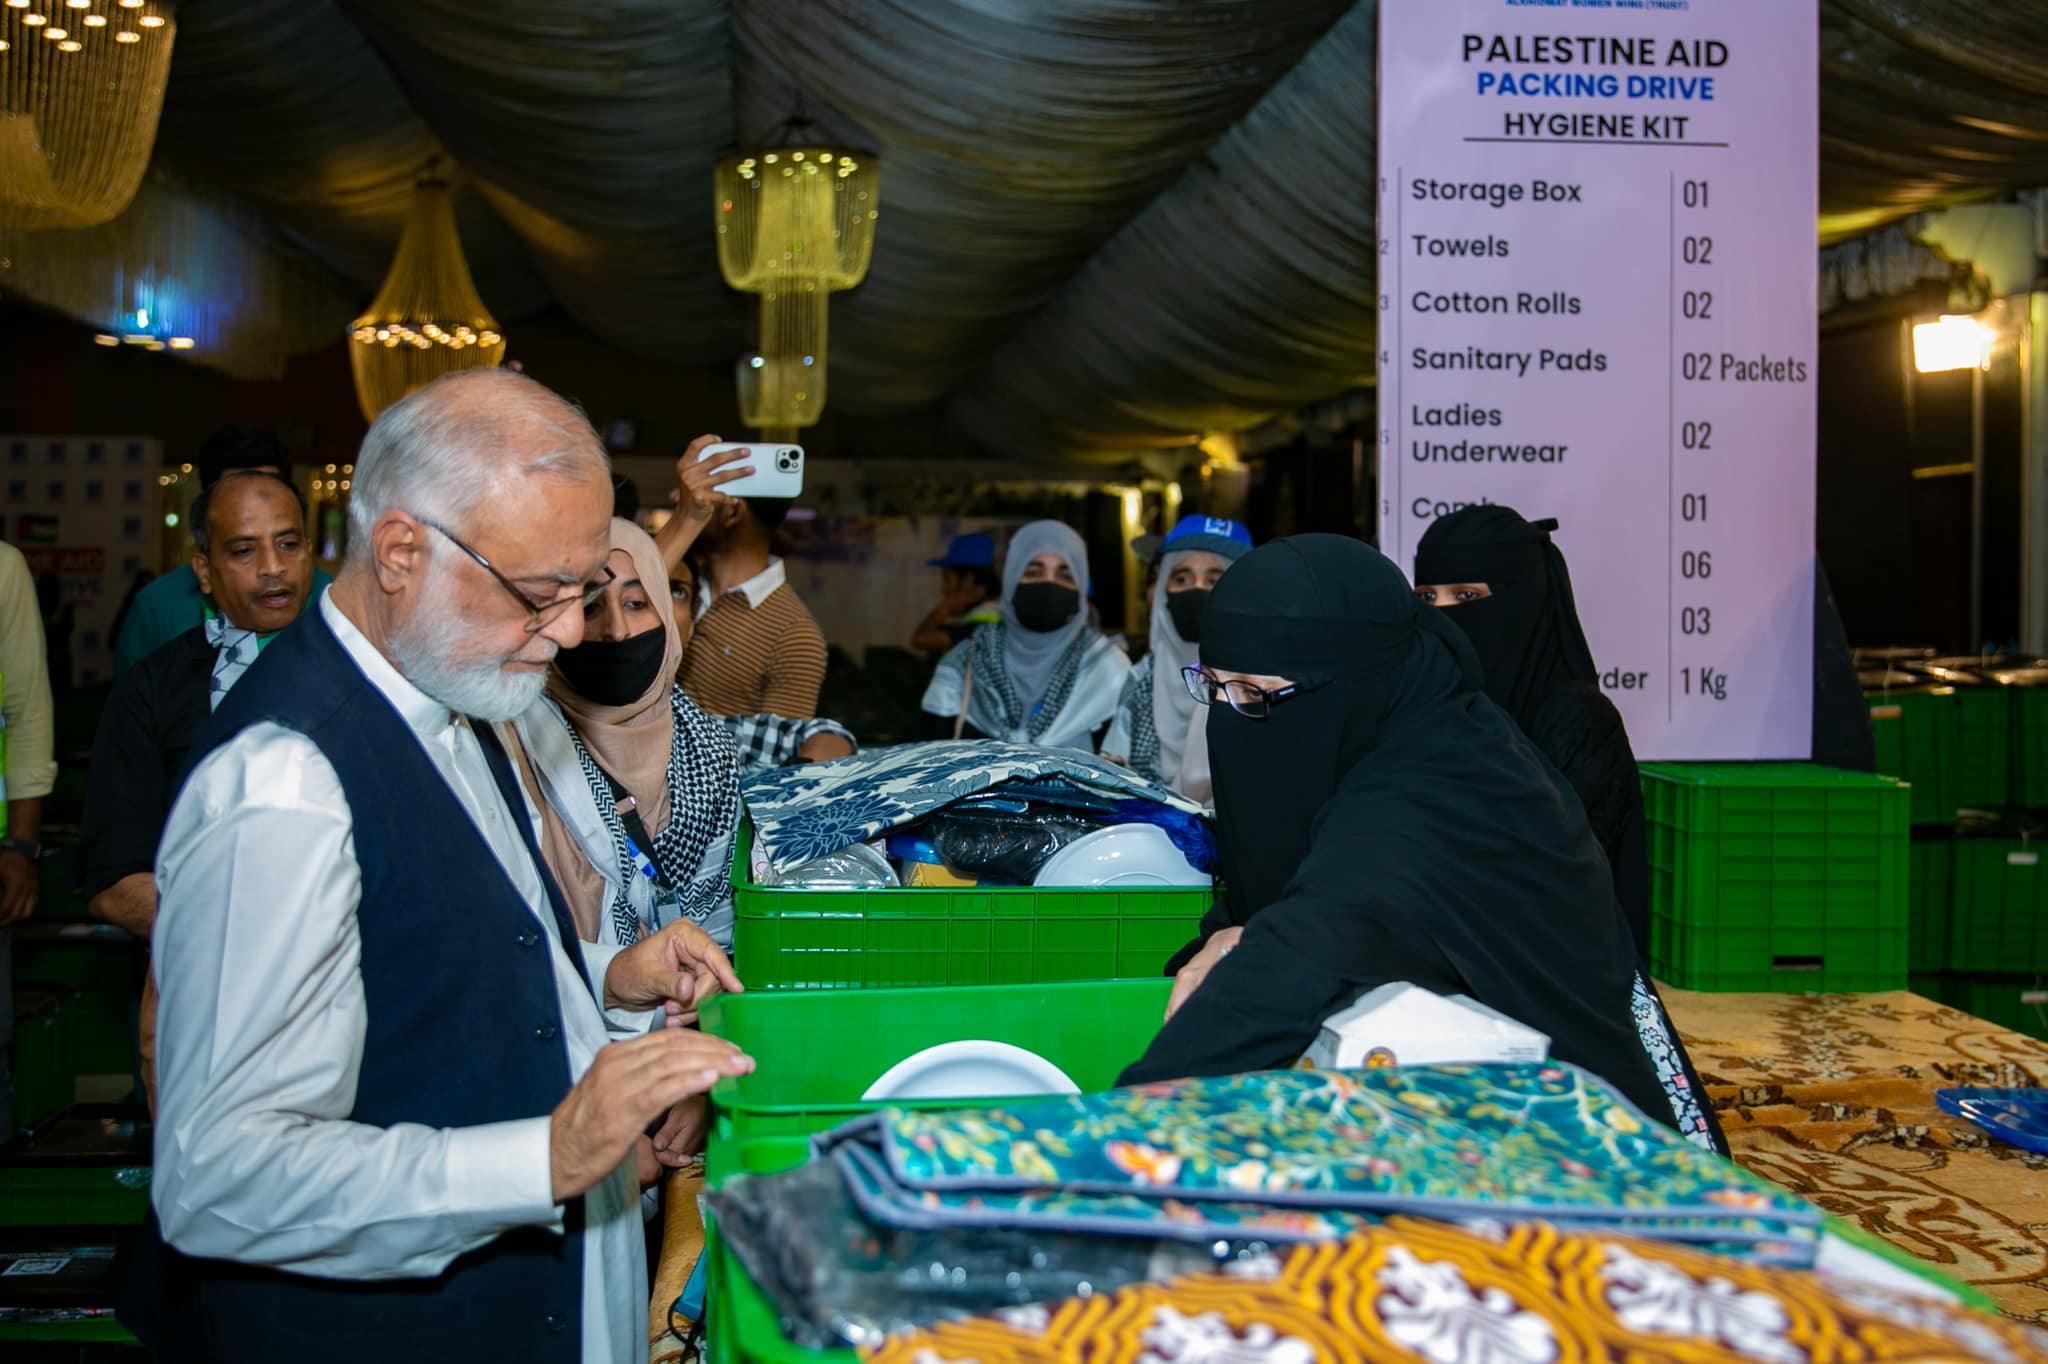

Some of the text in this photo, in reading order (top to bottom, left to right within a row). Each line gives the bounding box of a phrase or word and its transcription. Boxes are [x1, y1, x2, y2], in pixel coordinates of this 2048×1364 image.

[1463, 34, 1729, 68] PALESTINE AID
[1477, 72, 1715, 101] PACKING DRIVE
[1504, 112, 1689, 139] HYGIENE KIT
[1411, 178, 1582, 208] Storage Box
[1682, 180, 1709, 208] 01
[1411, 234, 1509, 258] Towels
[1682, 236, 1713, 265] 02
[1411, 290, 1582, 315] Cotton Rolls
[1682, 291, 1713, 320] 02
[1411, 346, 1607, 377] Sanitary Pads
[1682, 352, 1807, 383] 02 Packets
[1412, 402, 1503, 427] Ladies
[1681, 421, 1712, 450] 02
[1412, 440, 1568, 463] Underwear
[1681, 493, 1707, 521] 01
[1681, 551, 1712, 579] 06
[1681, 607, 1711, 636] 03
[1599, 666, 1648, 690] der
[1680, 667, 1728, 700] 1 Kg
